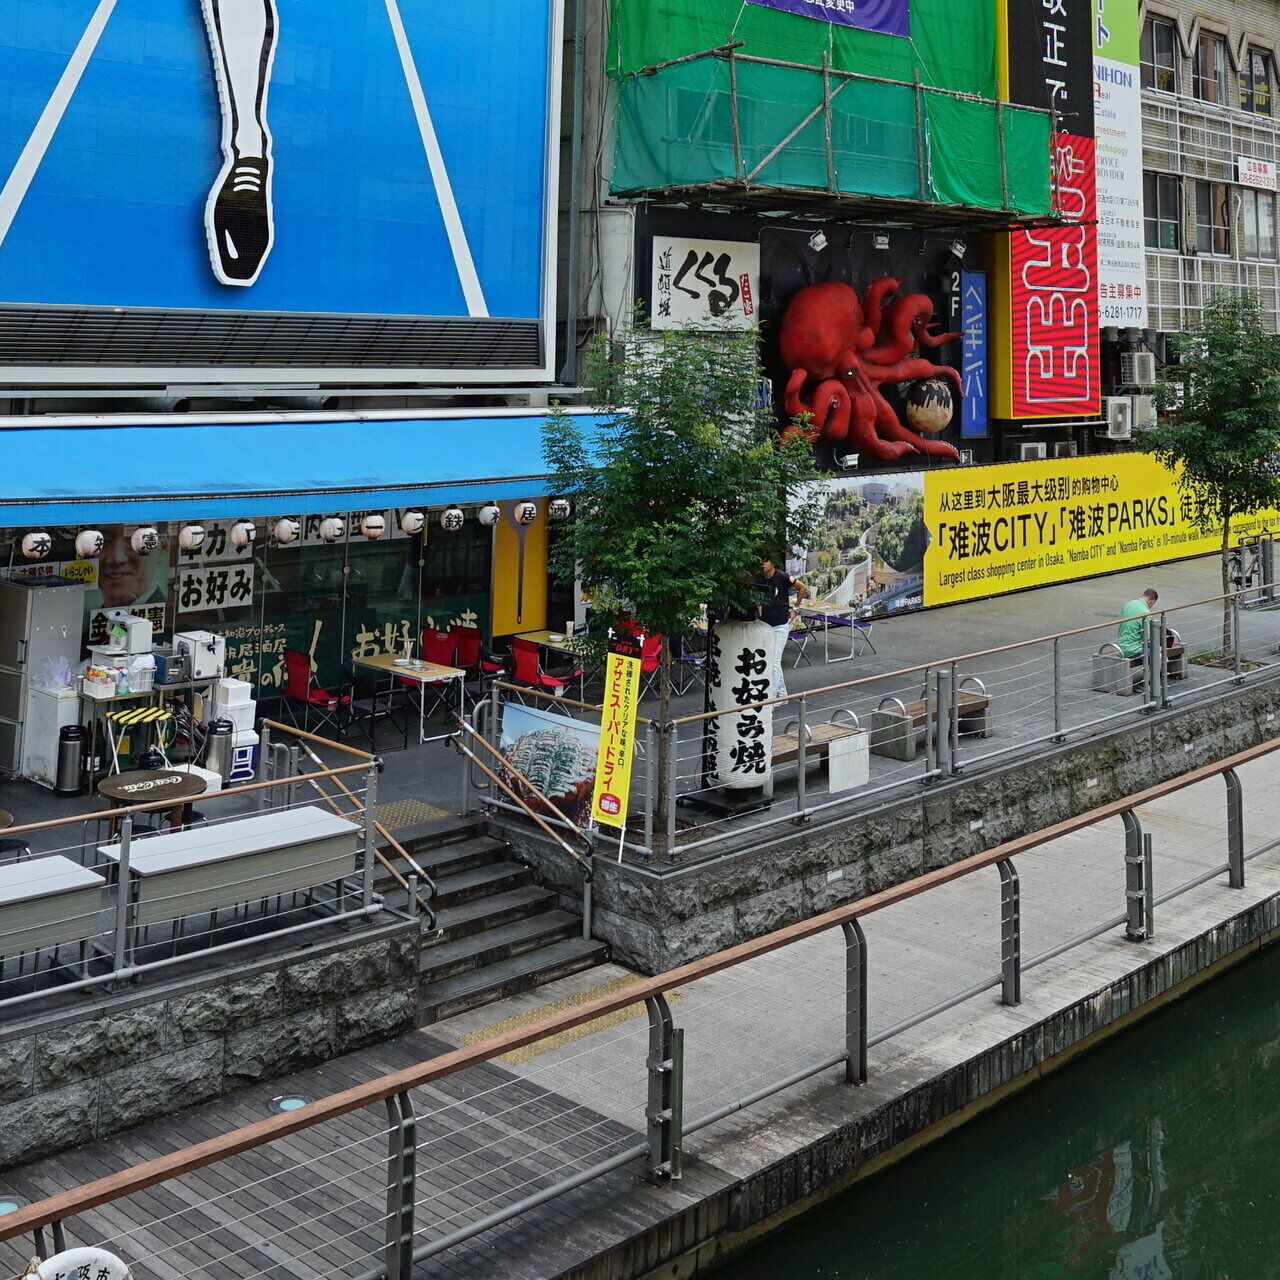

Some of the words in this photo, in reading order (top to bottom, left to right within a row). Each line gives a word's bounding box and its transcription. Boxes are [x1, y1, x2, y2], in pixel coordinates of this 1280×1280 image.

[1096, 155, 1119, 168] ERVICE
[1096, 169, 1125, 181] ROVIDER
[672, 249, 740, 317] くくる
[950, 273, 960, 317] 2F
[964, 286, 984, 421] ペンギンバー
[31, 536, 51, 556] 本
[445, 512, 462, 530] 鉄
[939, 568, 966, 587] Largest
[967, 566, 986, 581] class
[986, 561, 1016, 583] shopping
[1016, 557, 1037, 572] center
[1045, 551, 1066, 567] Osaka,
[1106, 541, 1117, 556] and
[1162, 531, 1187, 546] 10-minute
[1188, 528, 1200, 541] walk
[179, 567, 253, 609] お好み
[602, 656, 624, 791] アサヒスーパードライ
[729, 646, 771, 775] お好み焼
